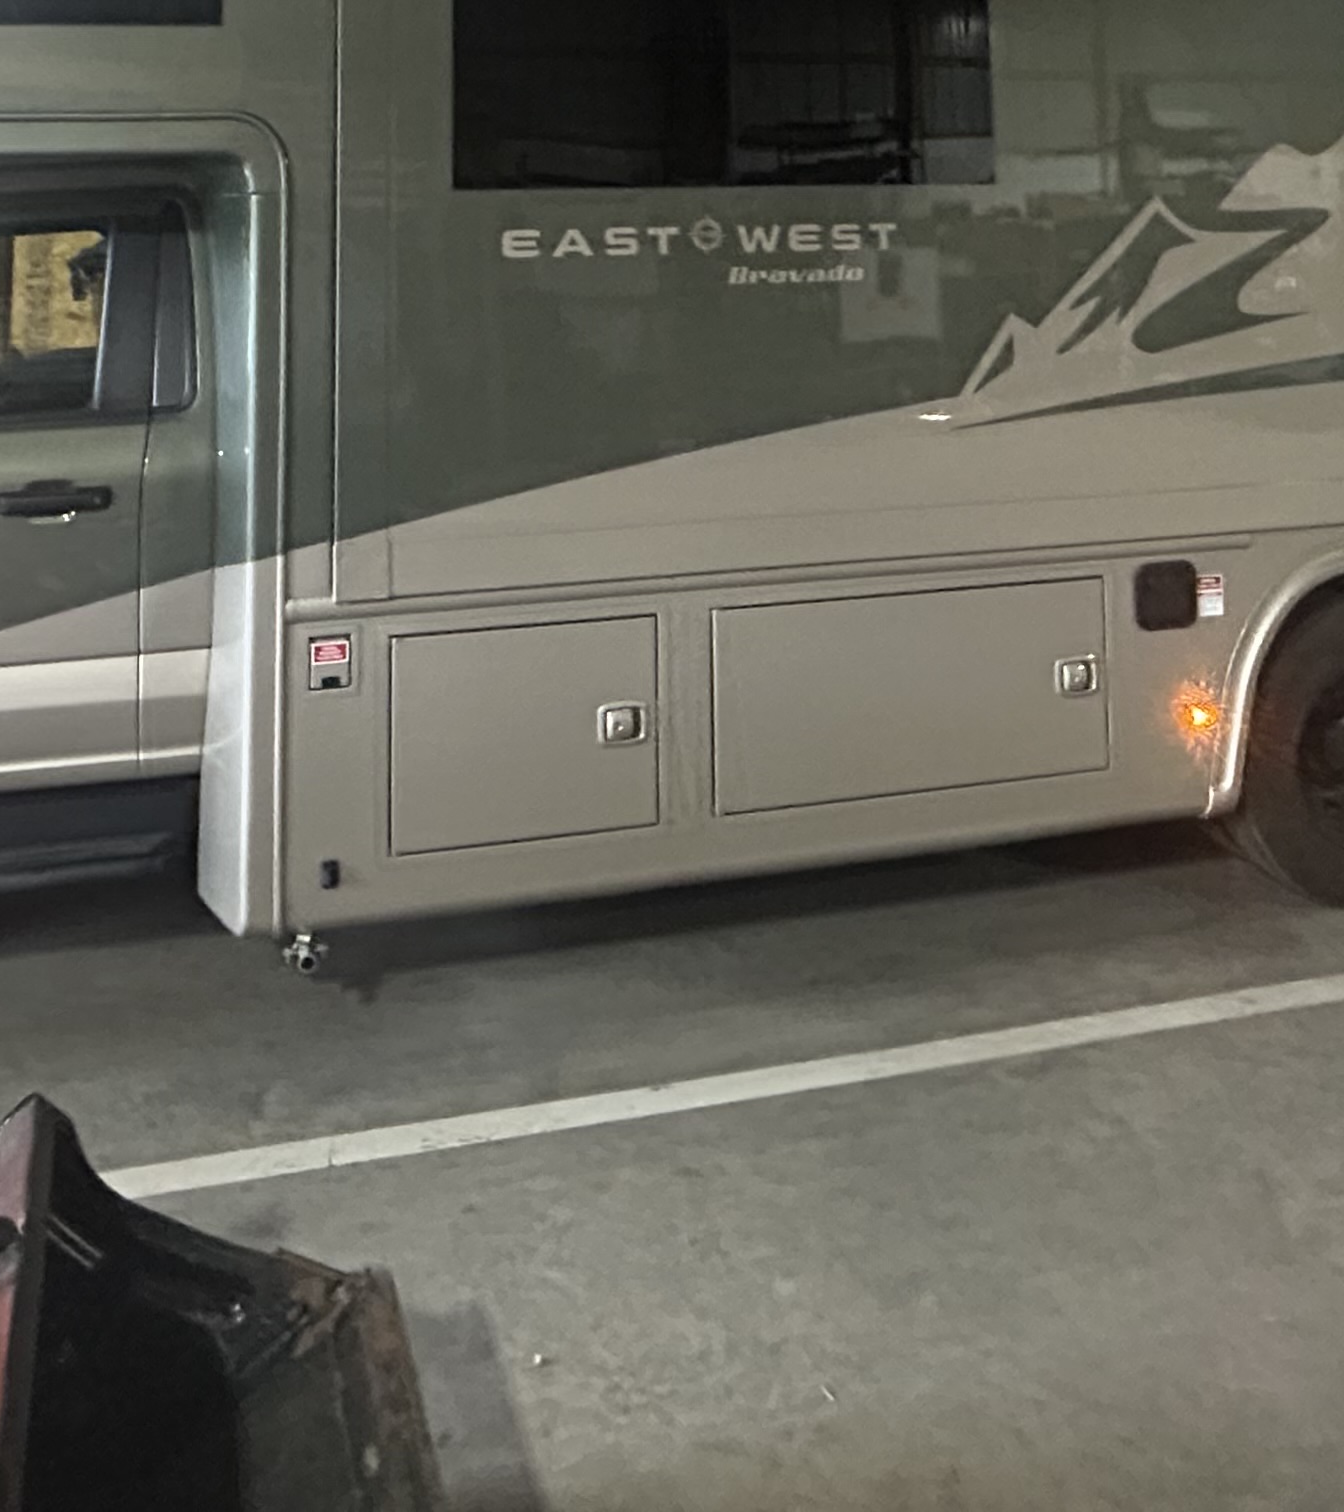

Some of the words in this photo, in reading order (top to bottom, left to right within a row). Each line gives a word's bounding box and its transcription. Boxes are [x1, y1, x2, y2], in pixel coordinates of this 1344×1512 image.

[501, 227, 679, 258] EAST
[738, 223, 897, 253] WEST
[728, 265, 864, 285] Bravado
